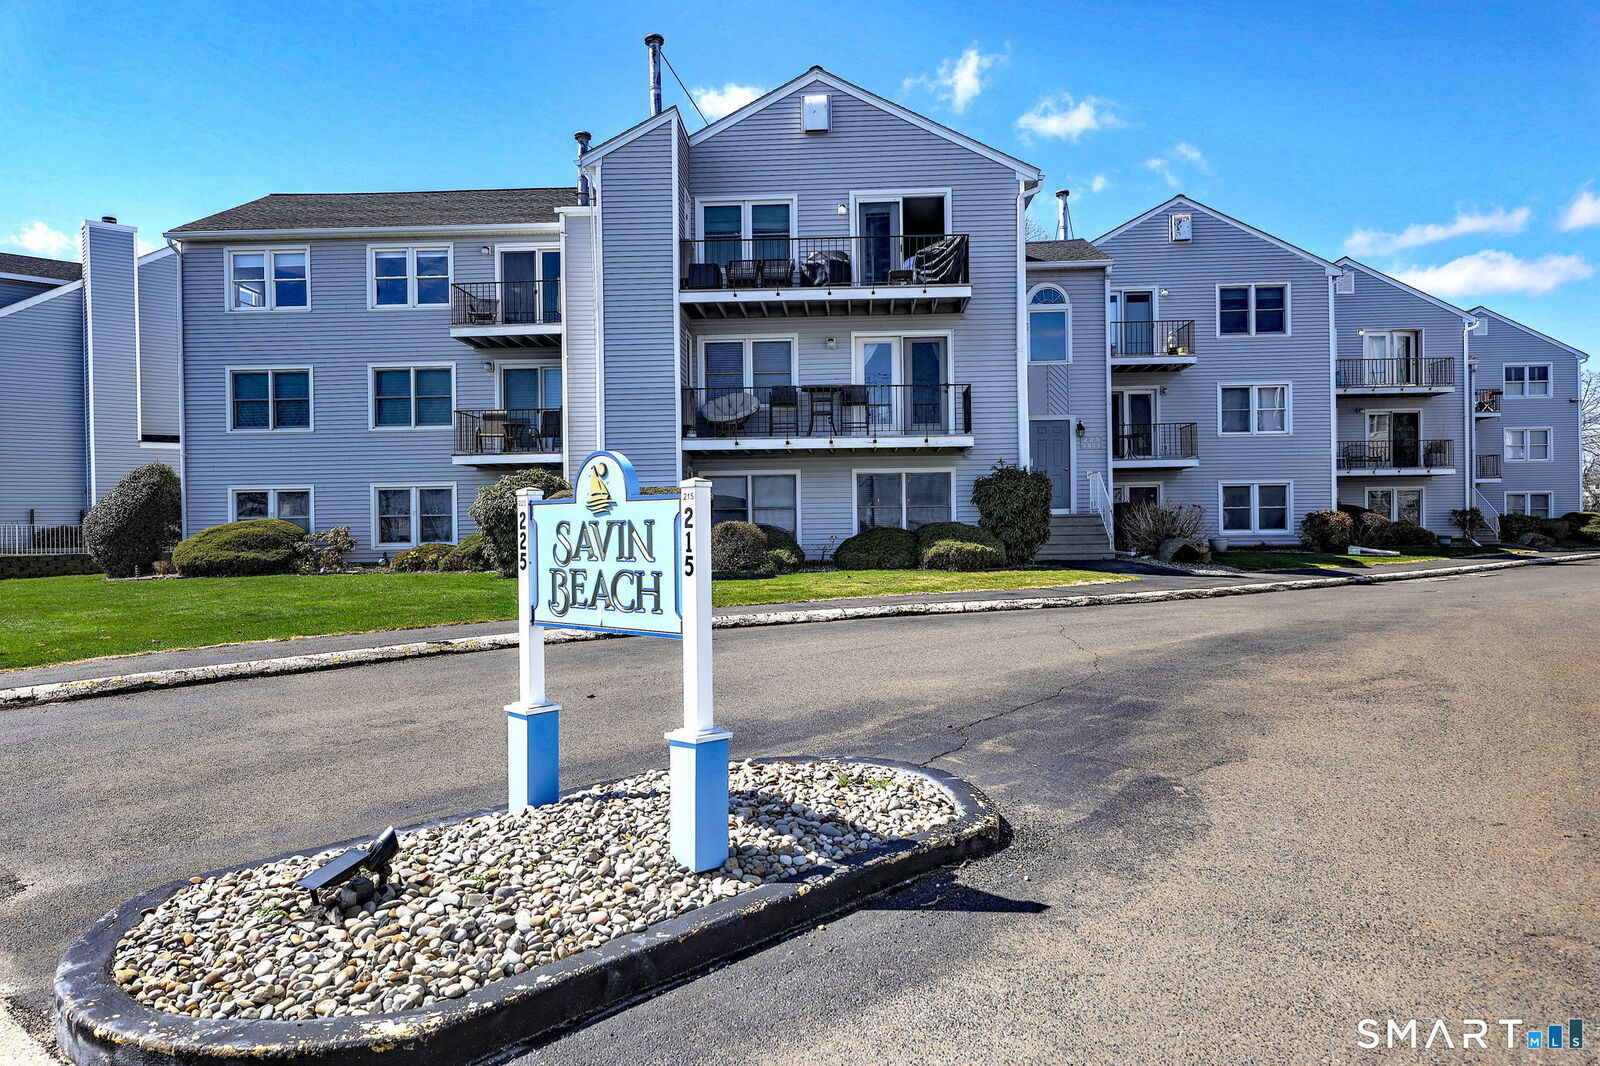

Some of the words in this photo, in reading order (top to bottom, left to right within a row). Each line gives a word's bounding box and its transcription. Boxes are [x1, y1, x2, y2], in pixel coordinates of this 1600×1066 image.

[683, 492, 695, 501] 215
[519, 511, 527, 571] 225
[552, 519, 656, 567] SAVIN
[684, 506, 694, 577] 215
[548, 568, 663, 618] BEACH
